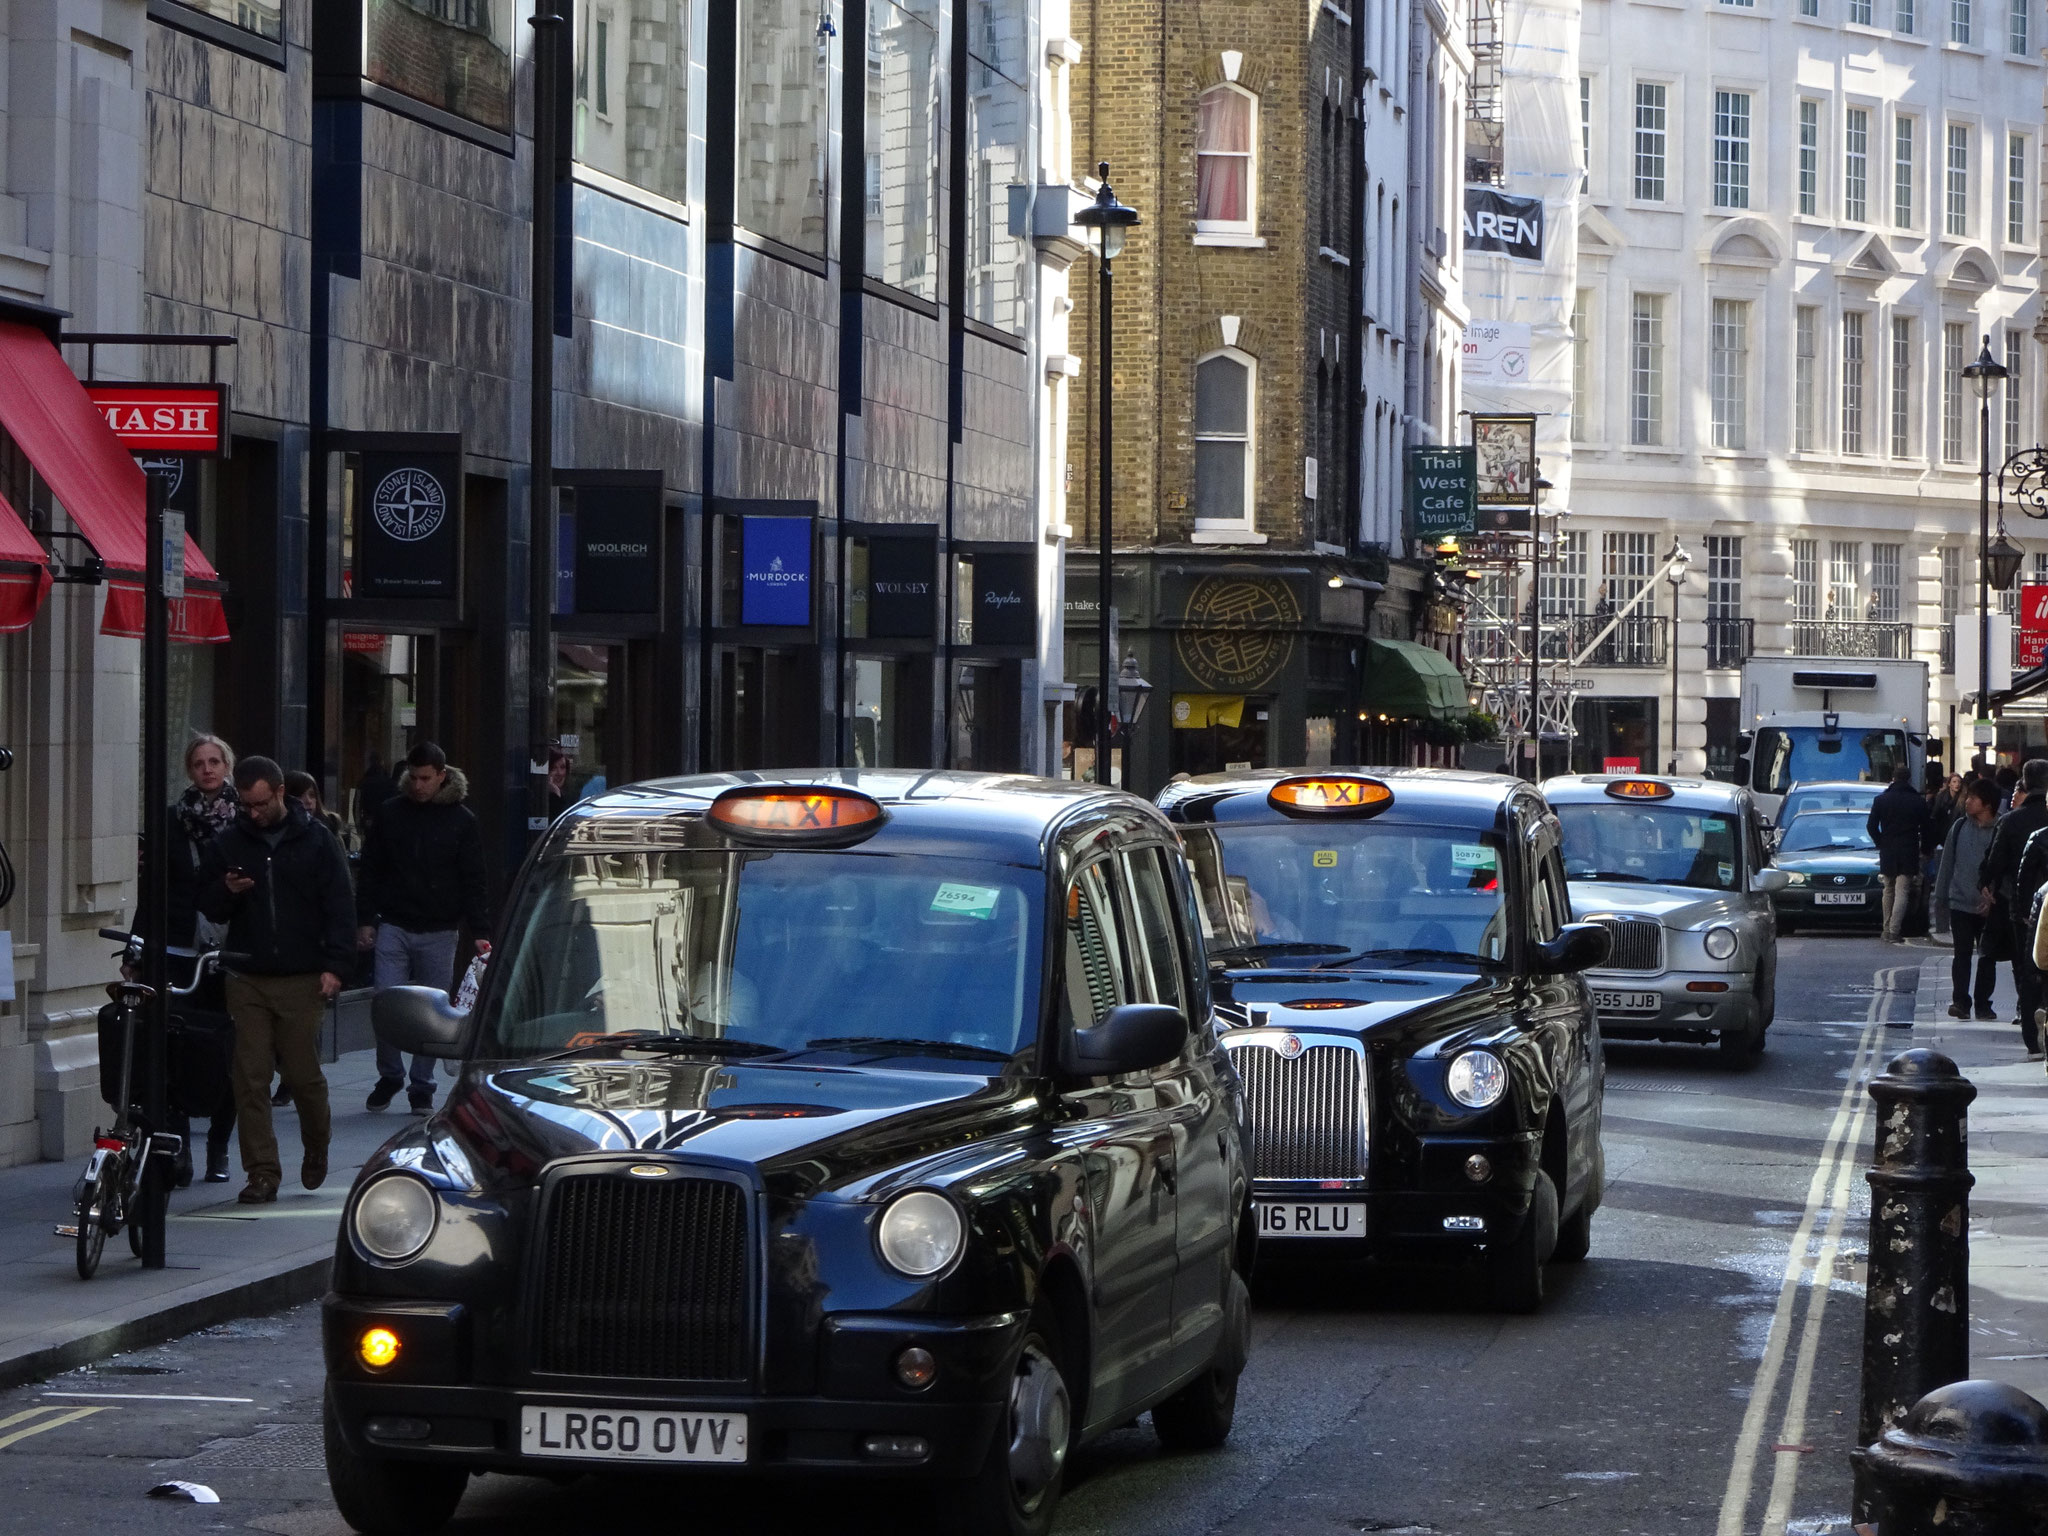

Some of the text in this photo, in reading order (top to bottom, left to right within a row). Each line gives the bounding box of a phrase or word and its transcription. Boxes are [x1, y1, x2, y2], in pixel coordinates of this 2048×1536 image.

[1463, 211, 1537, 246] AREN
[1421, 456, 1462, 469] Thai
[379, 472, 441, 503] STONE ISLAND
[1418, 477, 1466, 489] West
[1421, 496, 1464, 509] Cafe
[378, 506, 441, 536] ISLAND STONE
[587, 543, 648, 553] WOOLRICH
[749, 573, 805, 582] MURDOCK
[875, 583, 930, 594] WOLSEY
[984, 591, 1021, 610] Rapha
[1075, 600, 1094, 610] take
[938, 891, 976, 902] 76594
[1821, 894, 1862, 903] ML51 YXM
[1626, 995, 1655, 1008] JJB
[1263, 1205, 1349, 1232] 16 RLU
[540, 1412, 730, 1455] LR60 OVV
